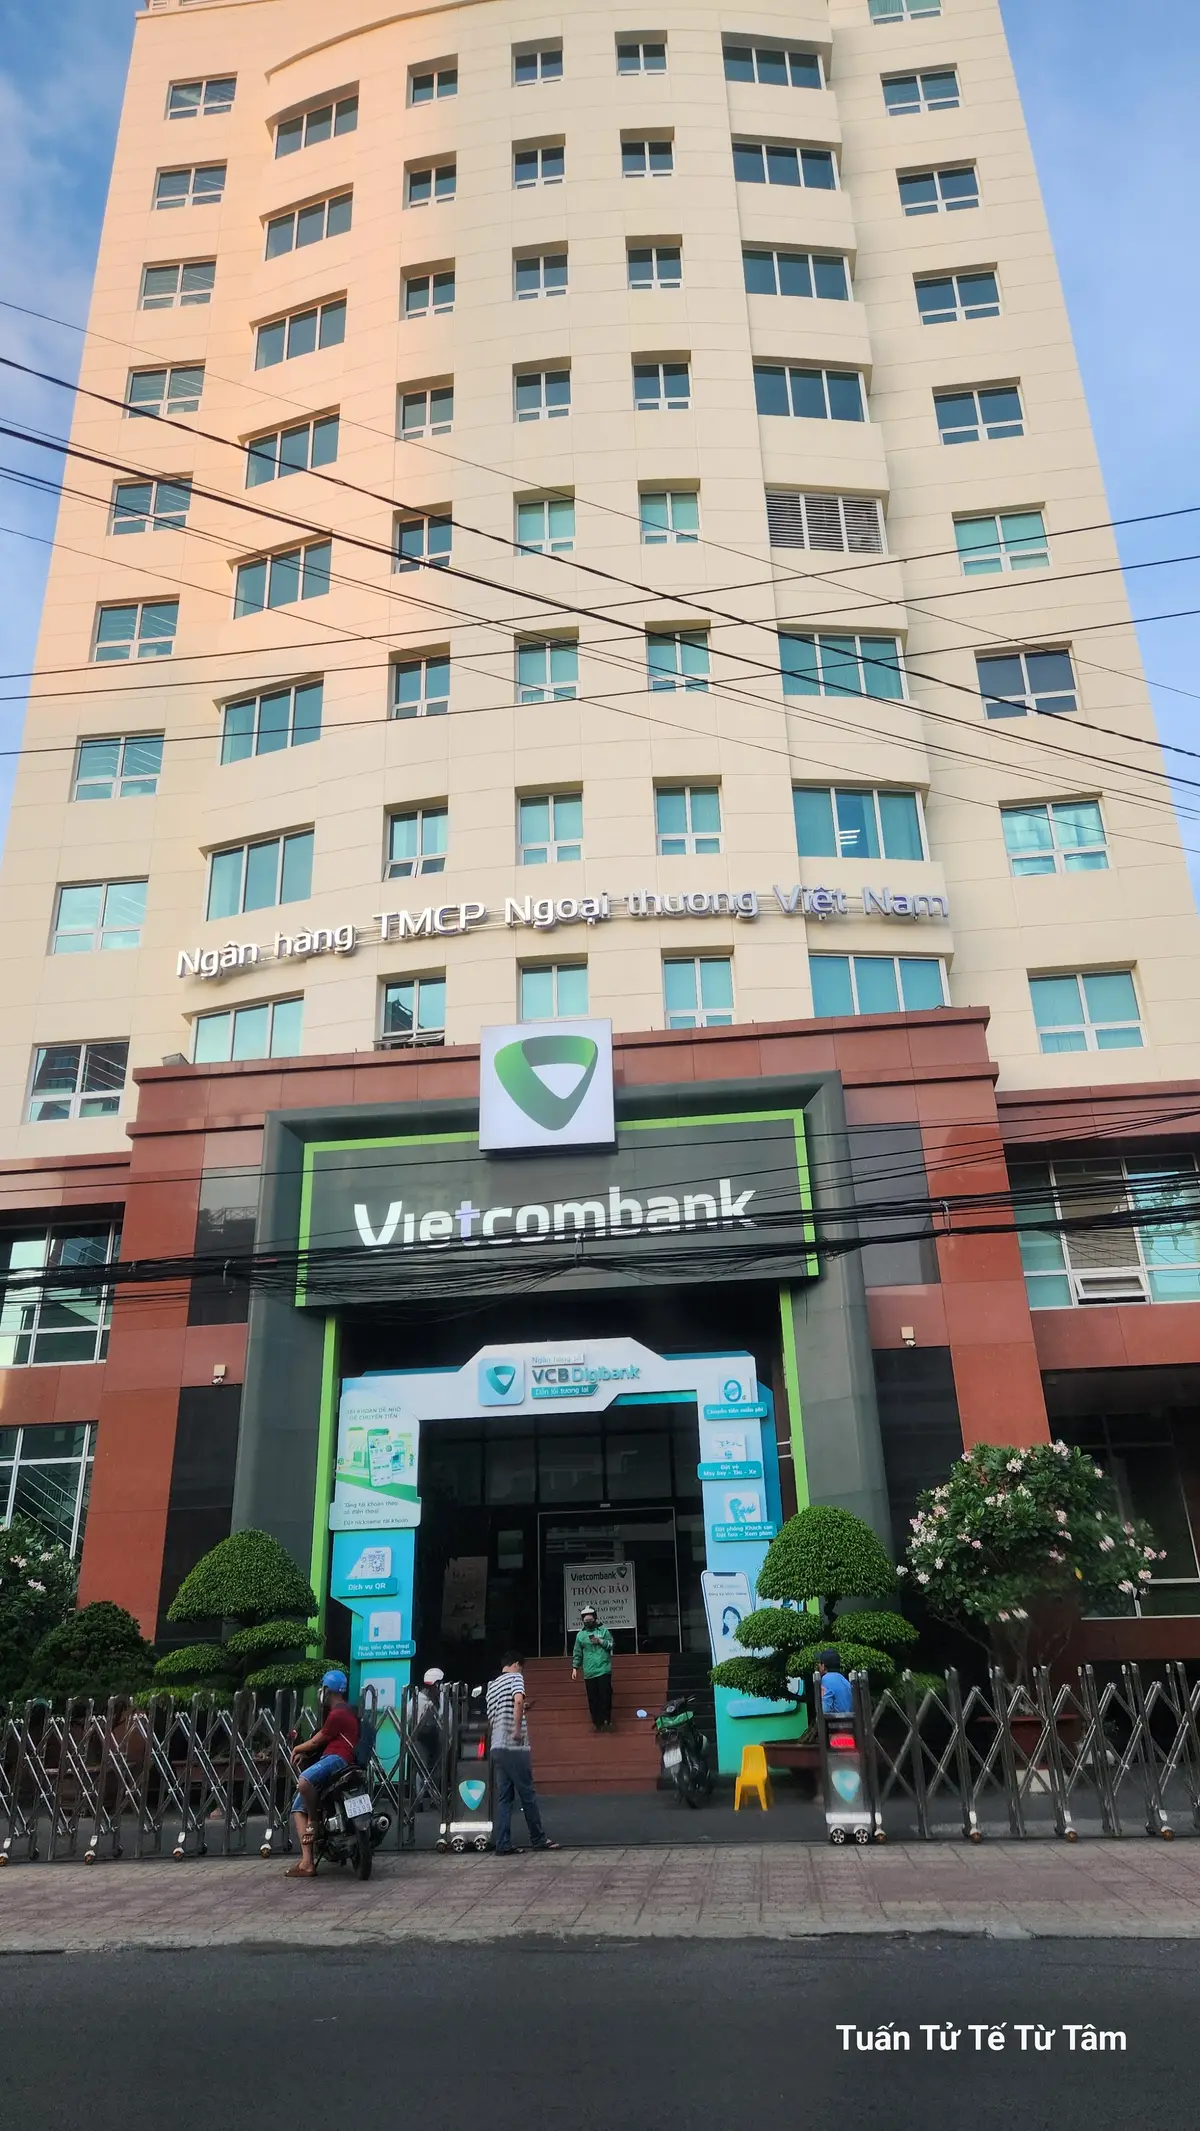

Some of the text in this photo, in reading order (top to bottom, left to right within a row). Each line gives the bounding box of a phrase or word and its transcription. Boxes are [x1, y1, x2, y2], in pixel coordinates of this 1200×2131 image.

[175, 939, 259, 980] Ngân
[273, 923, 357, 956] hàng
[372, 901, 488, 940] TMCP
[504, 889, 610, 931] Ngoại
[773, 884, 849, 920] Việt
[861, 885, 949, 919] Nam
[353, 1178, 757, 1253] Vietcombank
[572, 1364, 640, 1384] Digibank
[570, 1571, 617, 1582] Vietcombank
[374, 1582, 386, 1590] QR
[571, 1585, 606, 1596] THÔNG
